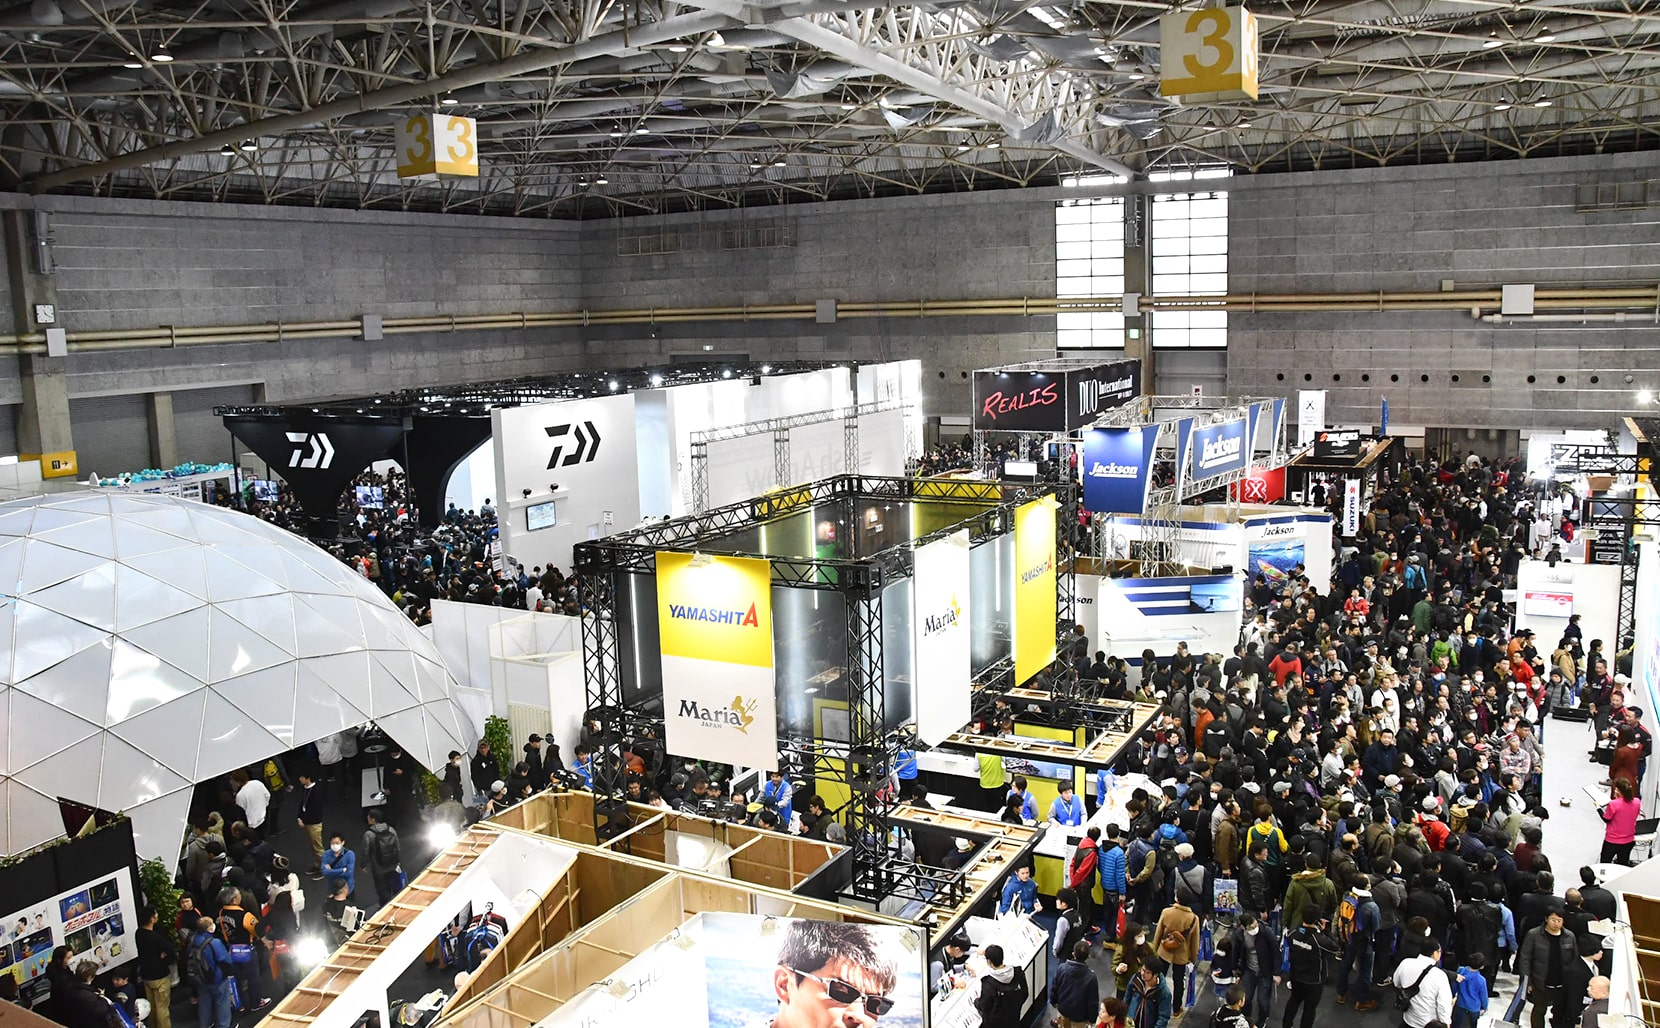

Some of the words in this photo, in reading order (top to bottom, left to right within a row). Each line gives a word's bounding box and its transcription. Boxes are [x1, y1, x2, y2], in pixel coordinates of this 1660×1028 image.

[1183, 8, 1234, 79] 3
[1246, 13, 1257, 78] 3
[406, 115, 431, 164] 3
[447, 115, 474, 164] 3
[982, 382, 1058, 420] REALIS
[1079, 379, 1098, 416] DUO
[1098, 374, 1133, 395] International
[1199, 434, 1241, 466] Jackson
[1089, 462, 1139, 476] Jackson
[1261, 526, 1295, 538] Jackson
[1021, 551, 1053, 585] YAMASHITA
[669, 600, 759, 628] YAMASHITA
[924, 608, 956, 637] Maria
[678, 699, 742, 726] Maria
[701, 721, 722, 729] JAPAN
